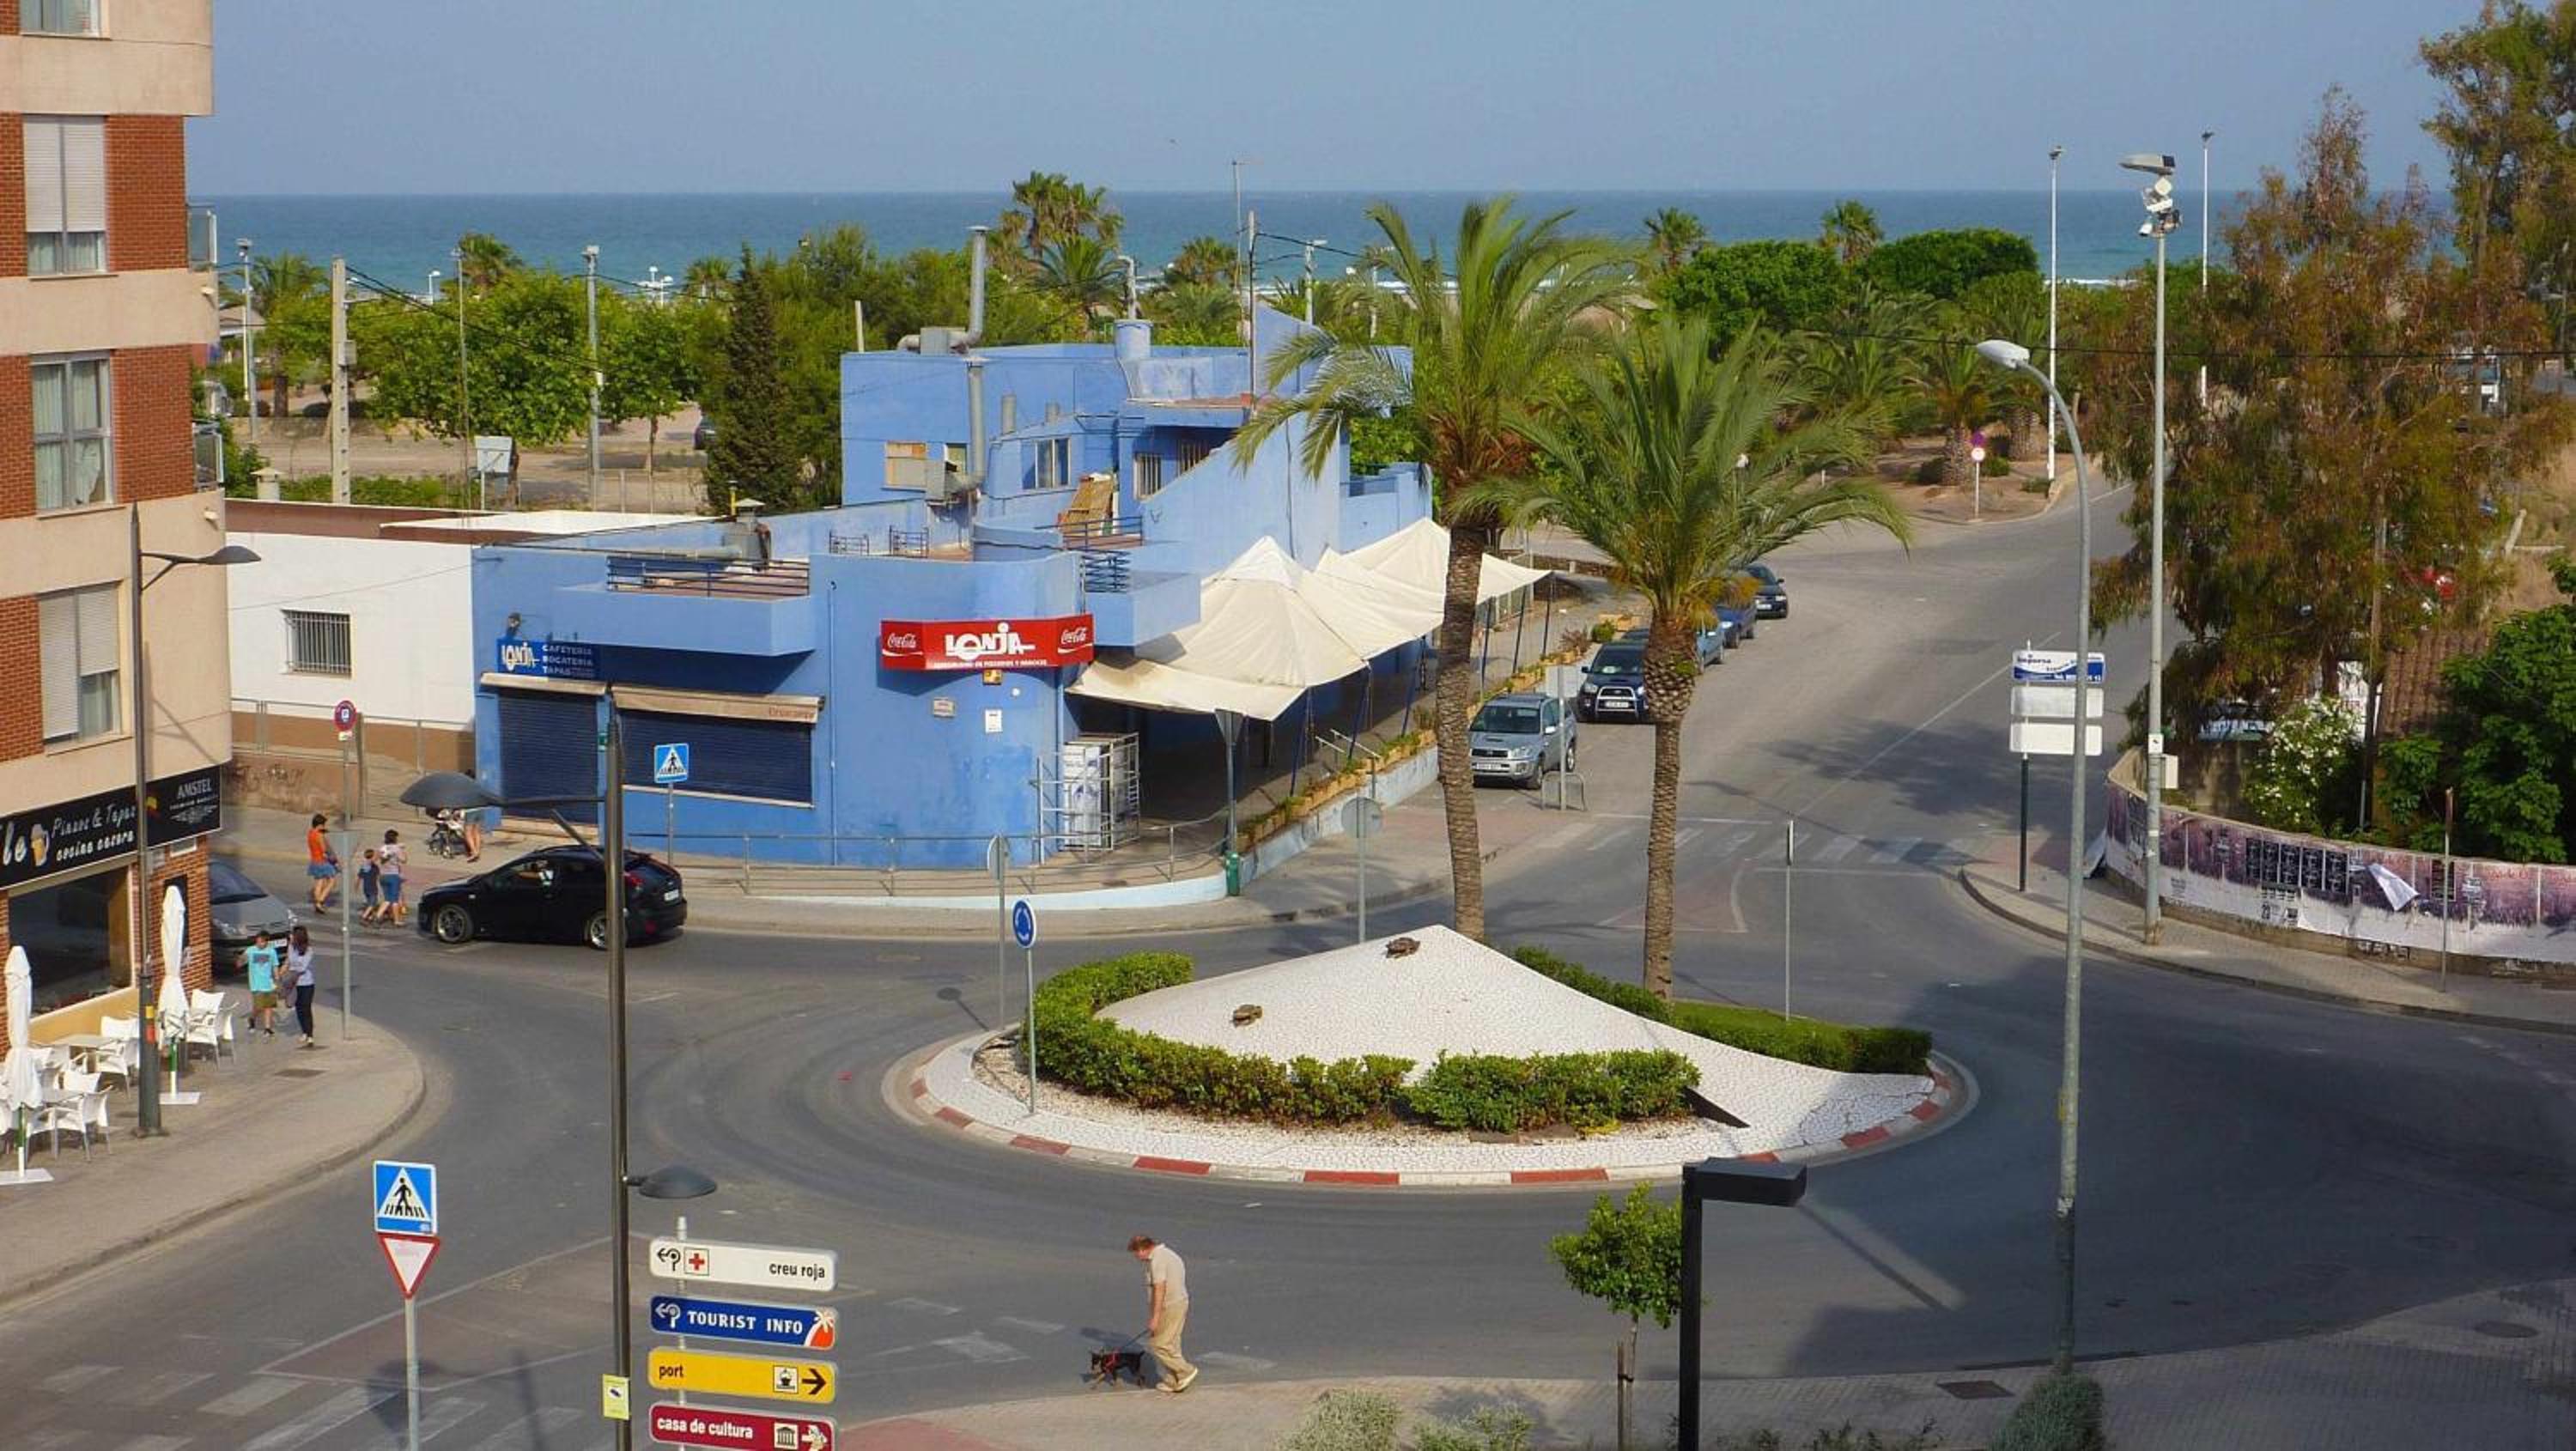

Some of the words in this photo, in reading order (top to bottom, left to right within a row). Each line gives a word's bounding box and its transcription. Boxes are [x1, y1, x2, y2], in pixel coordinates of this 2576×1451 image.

[177, 777, 212, 798] AMSTEL
[92, 807, 103, 828] &
[769, 1261, 798, 1276] creu
[801, 1263, 825, 1280] roja
[688, 1310, 756, 1330] TOURIST
[767, 1319, 803, 1334] INFO
[659, 1363, 684, 1379] port
[657, 1417, 687, 1432] casa
[690, 1419, 706, 1433] de
[708, 1422, 753, 1440] cultura
